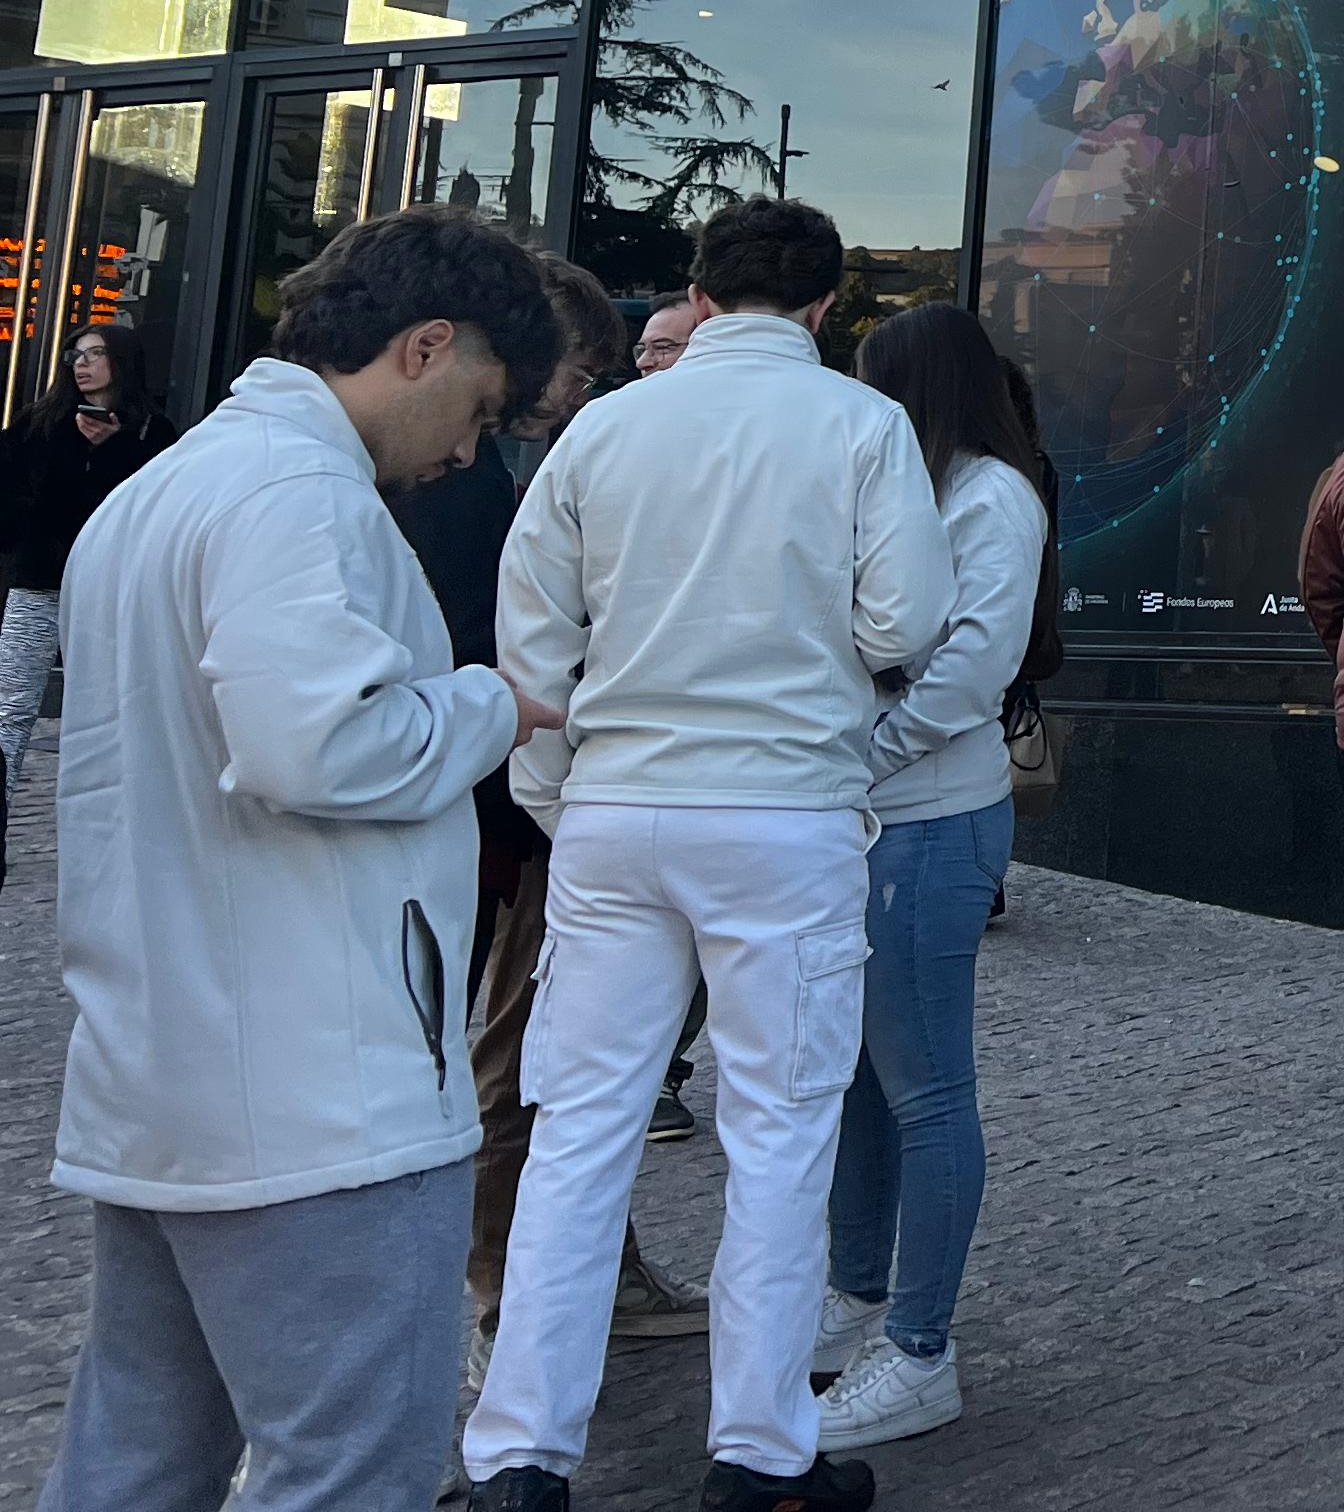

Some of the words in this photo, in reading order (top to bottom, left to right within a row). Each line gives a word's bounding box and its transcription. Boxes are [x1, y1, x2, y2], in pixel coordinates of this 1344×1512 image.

[1166, 596, 1195, 608] Fondos
[1197, 597, 1235, 610] Europeos
[1288, 604, 1306, 613] Anda
